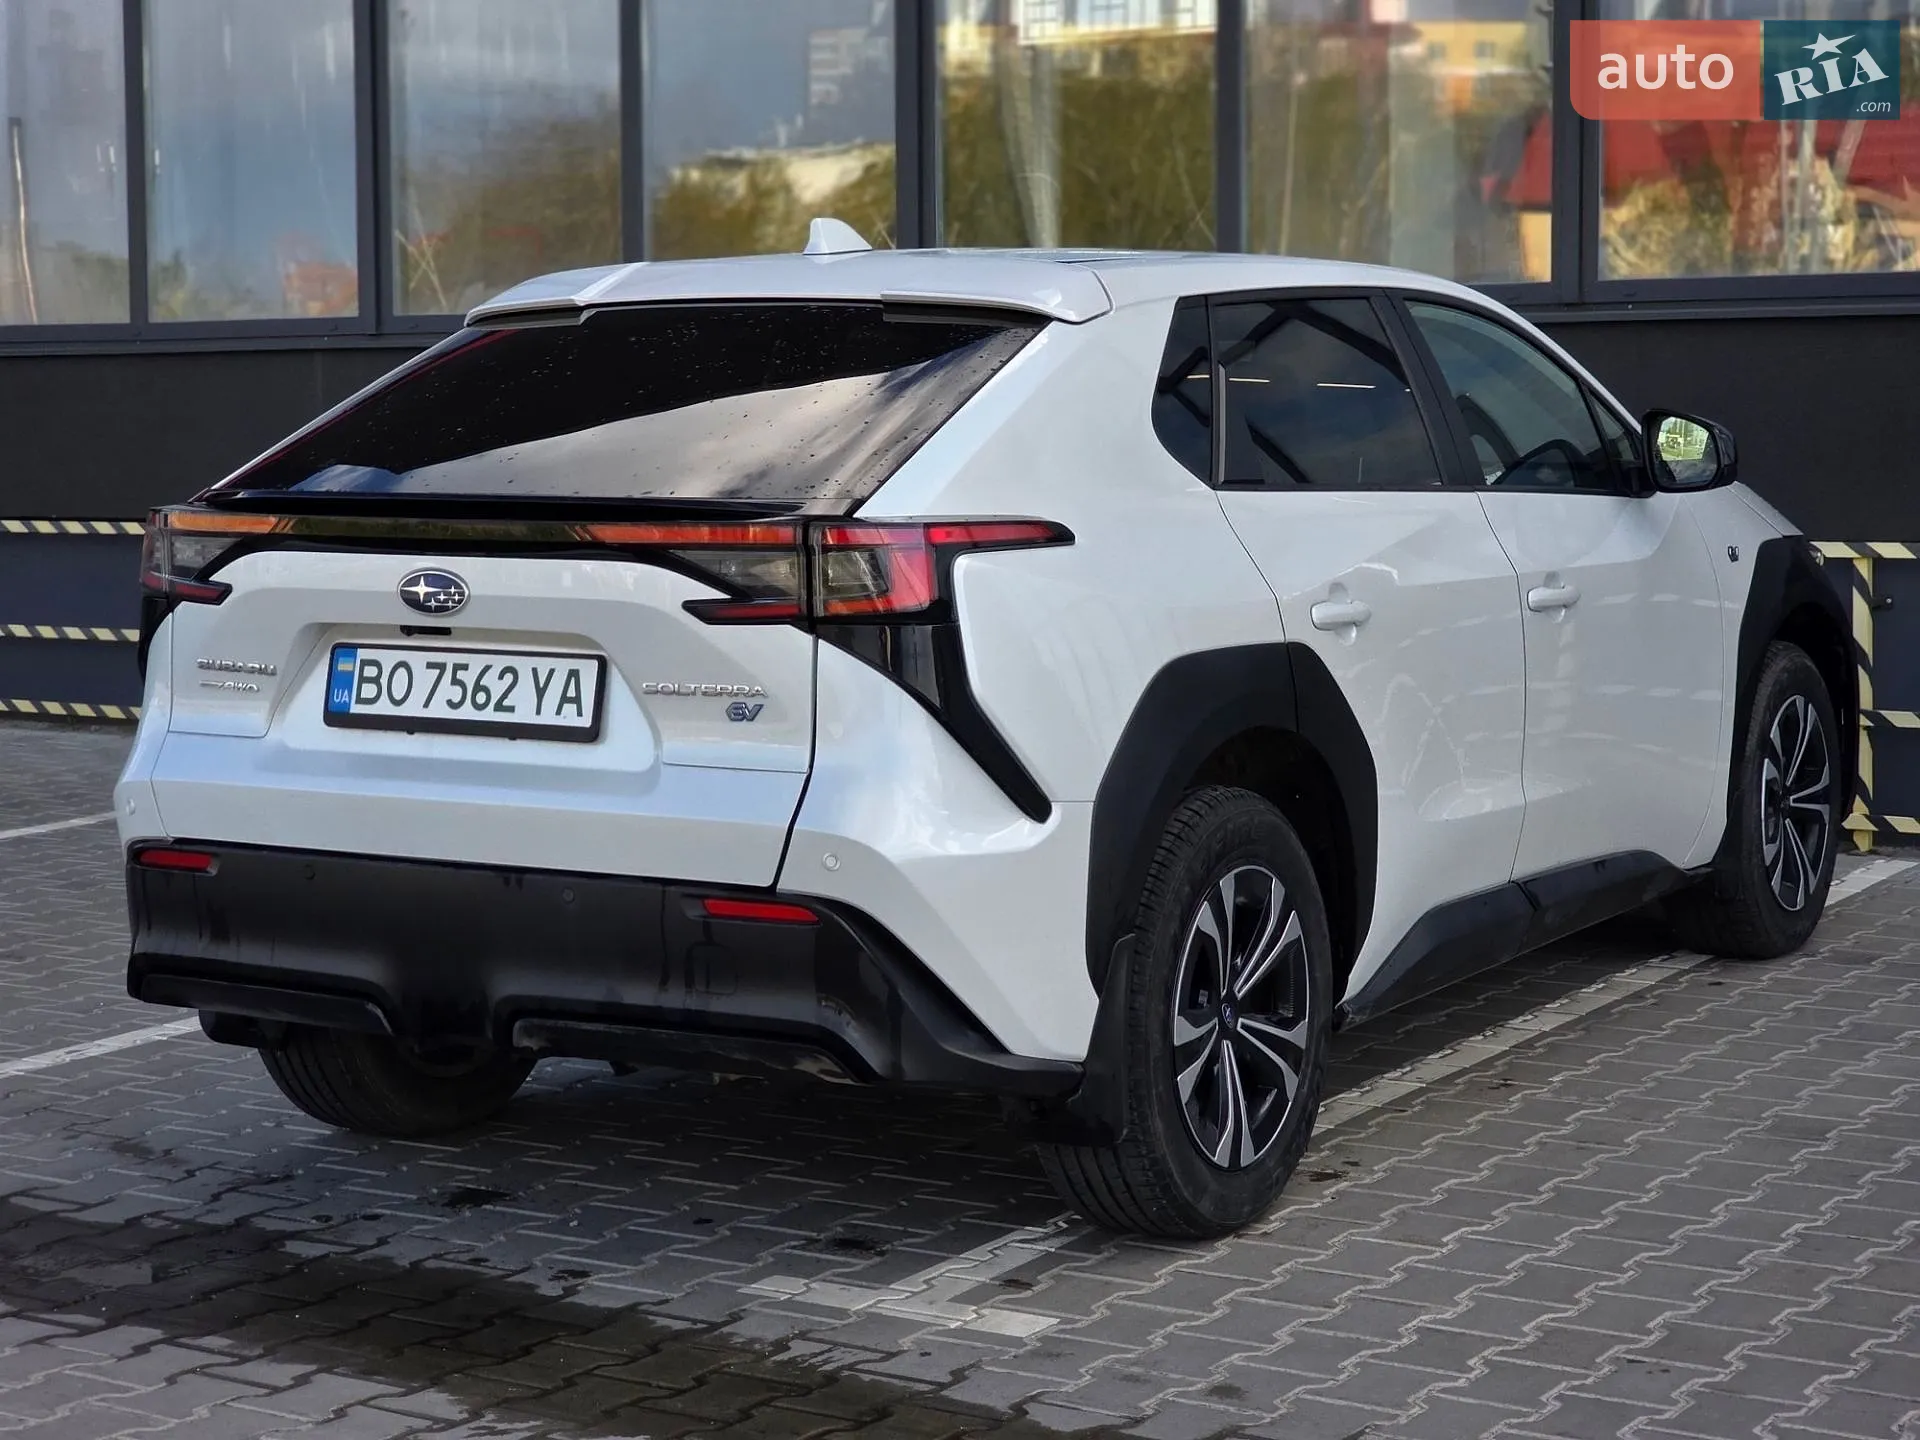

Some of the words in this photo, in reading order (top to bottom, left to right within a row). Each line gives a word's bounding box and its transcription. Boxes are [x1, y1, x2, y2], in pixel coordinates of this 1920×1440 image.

[197, 658, 278, 677] SUBARU
[333, 688, 350, 703] UA
[354, 657, 414, 708] BO
[422, 660, 520, 714] 7562
[530, 666, 584, 718] YA
[642, 682, 768, 698] SOLTERRA
[725, 701, 765, 722] EV
